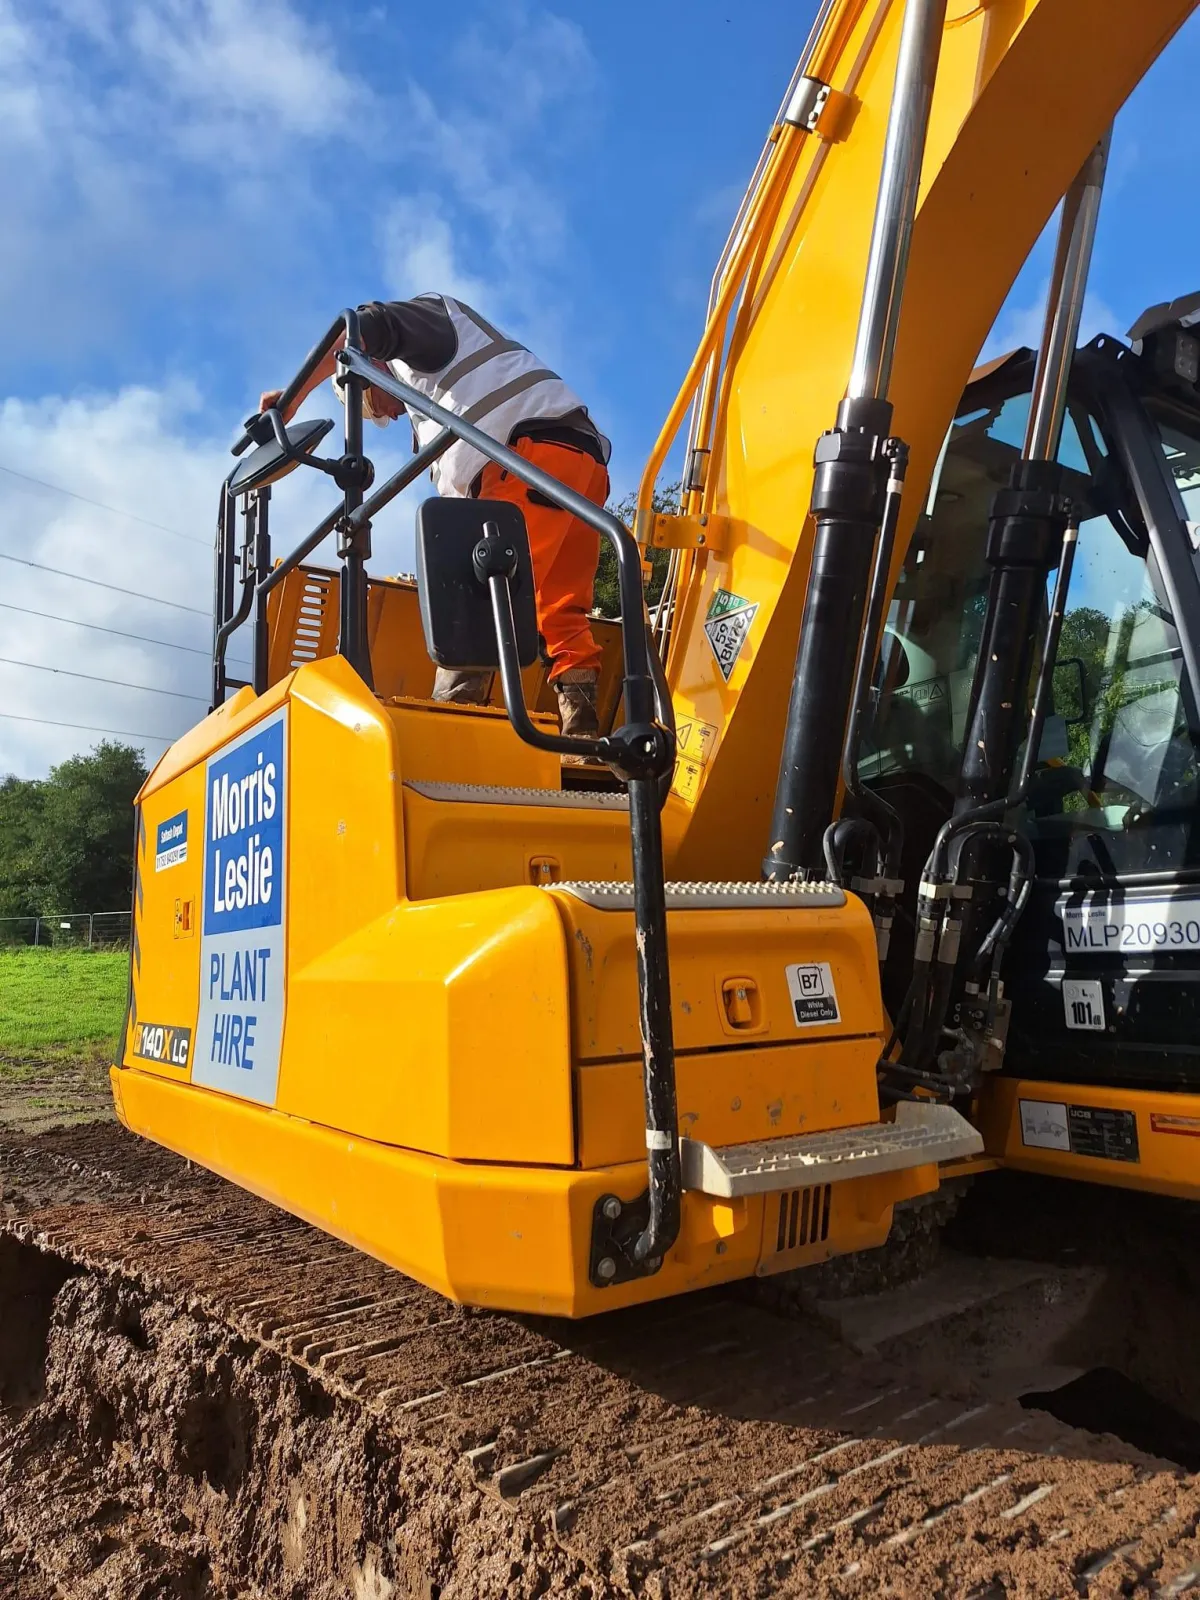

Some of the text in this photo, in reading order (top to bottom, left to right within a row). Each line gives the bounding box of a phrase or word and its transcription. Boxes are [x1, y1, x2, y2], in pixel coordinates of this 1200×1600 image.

[715, 623, 728, 645] 59
[212, 752, 276, 841] Morris
[214, 833, 273, 913] Leslie
[1067, 921, 1200, 948] MLP20930
[209, 948, 271, 1002] PLANT
[801, 974, 818, 989] B7
[800, 1009, 834, 1018] Diesel Only
[807, 1001, 824, 1009] White
[172, 1039, 188, 1064] LC
[211, 1013, 257, 1070] HIRE
